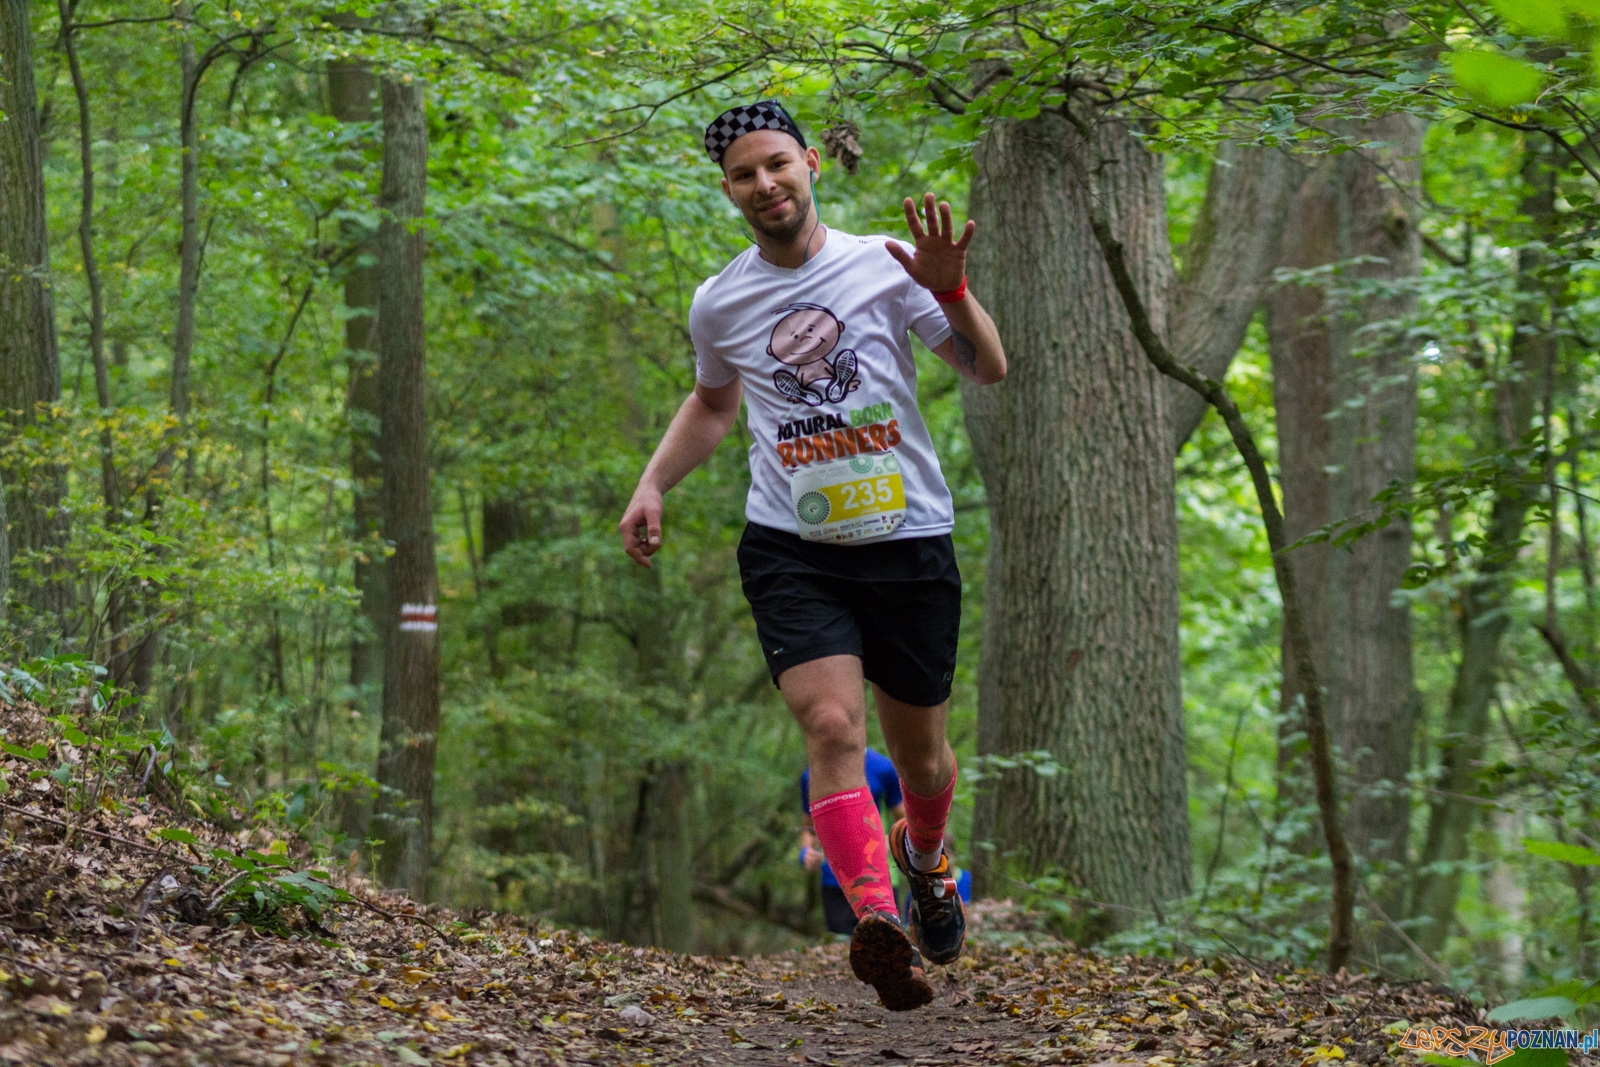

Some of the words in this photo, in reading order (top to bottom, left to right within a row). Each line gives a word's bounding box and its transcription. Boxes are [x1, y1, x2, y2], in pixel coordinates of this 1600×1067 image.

[778, 413, 847, 442] NATURAL
[849, 401, 895, 428] BORN
[776, 419, 902, 468] RUNNERS
[840, 478, 893, 510] 235
